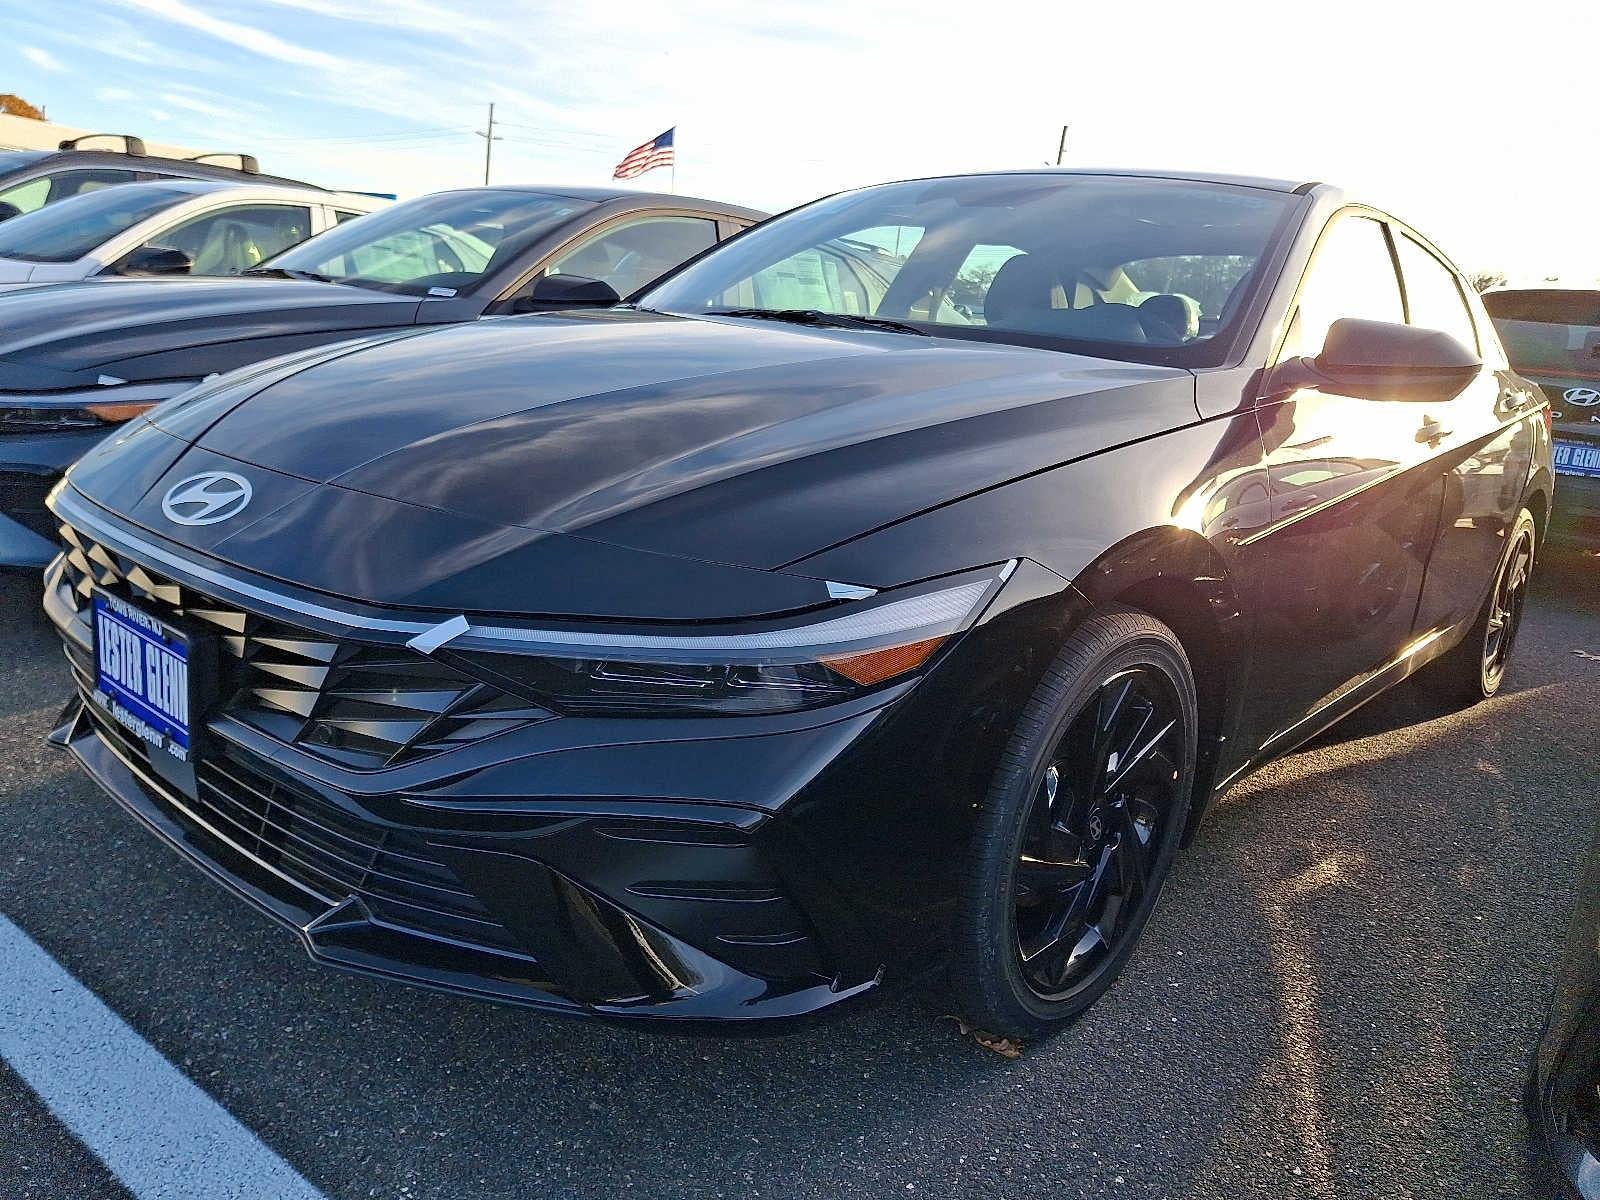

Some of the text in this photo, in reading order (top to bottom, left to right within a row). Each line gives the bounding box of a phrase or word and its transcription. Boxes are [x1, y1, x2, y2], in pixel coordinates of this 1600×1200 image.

[97, 613, 188, 727] LESTER GLENN
[111, 700, 163, 749] lesterglenn
